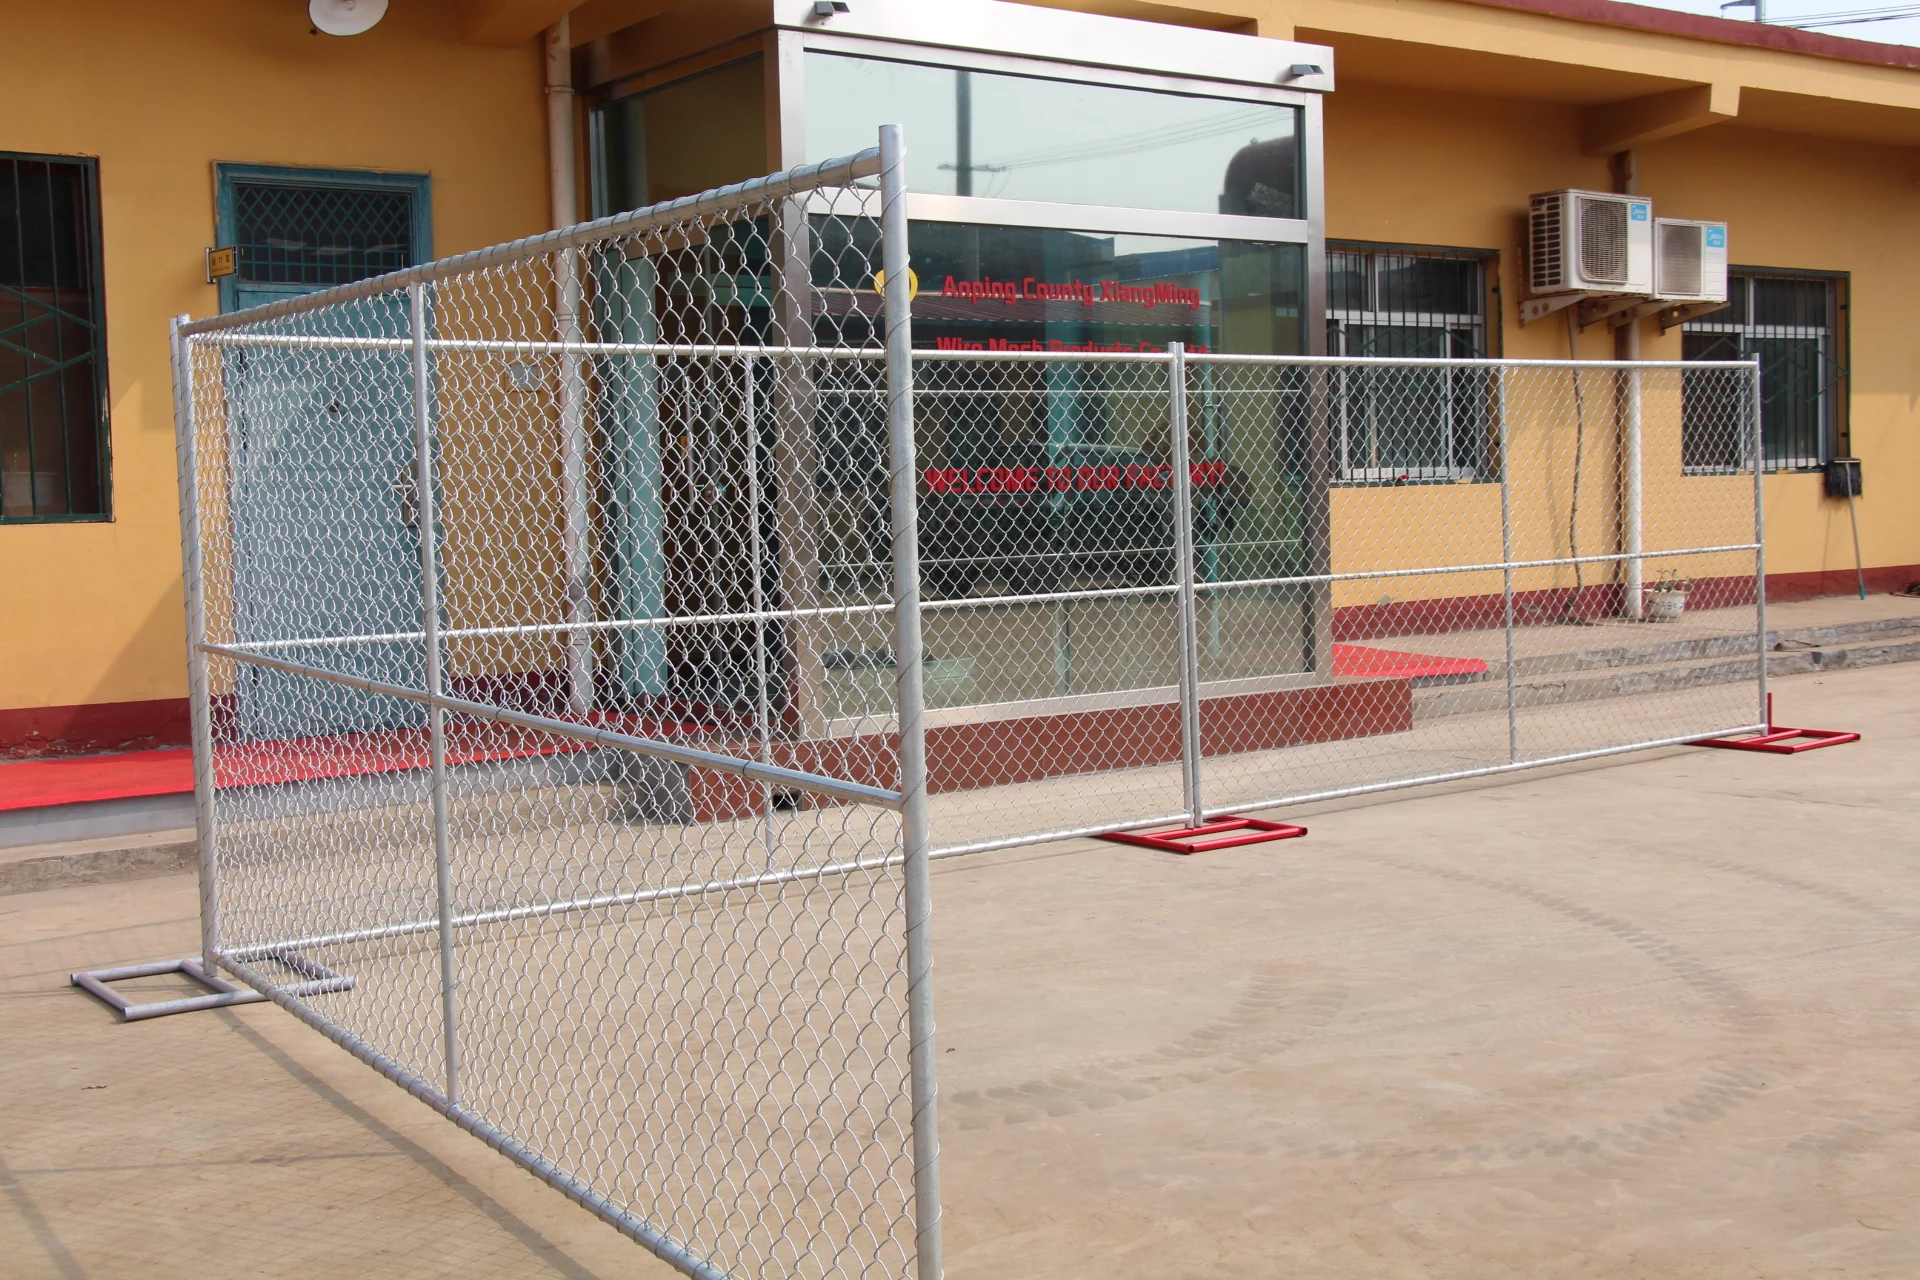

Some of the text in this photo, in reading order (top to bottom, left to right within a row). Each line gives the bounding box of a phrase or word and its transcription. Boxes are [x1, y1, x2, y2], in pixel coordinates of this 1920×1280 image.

[942, 275, 1201, 310] Anping County XiangMing
[925, 461, 1226, 493] WELCOME TO OUR FACTRY!
